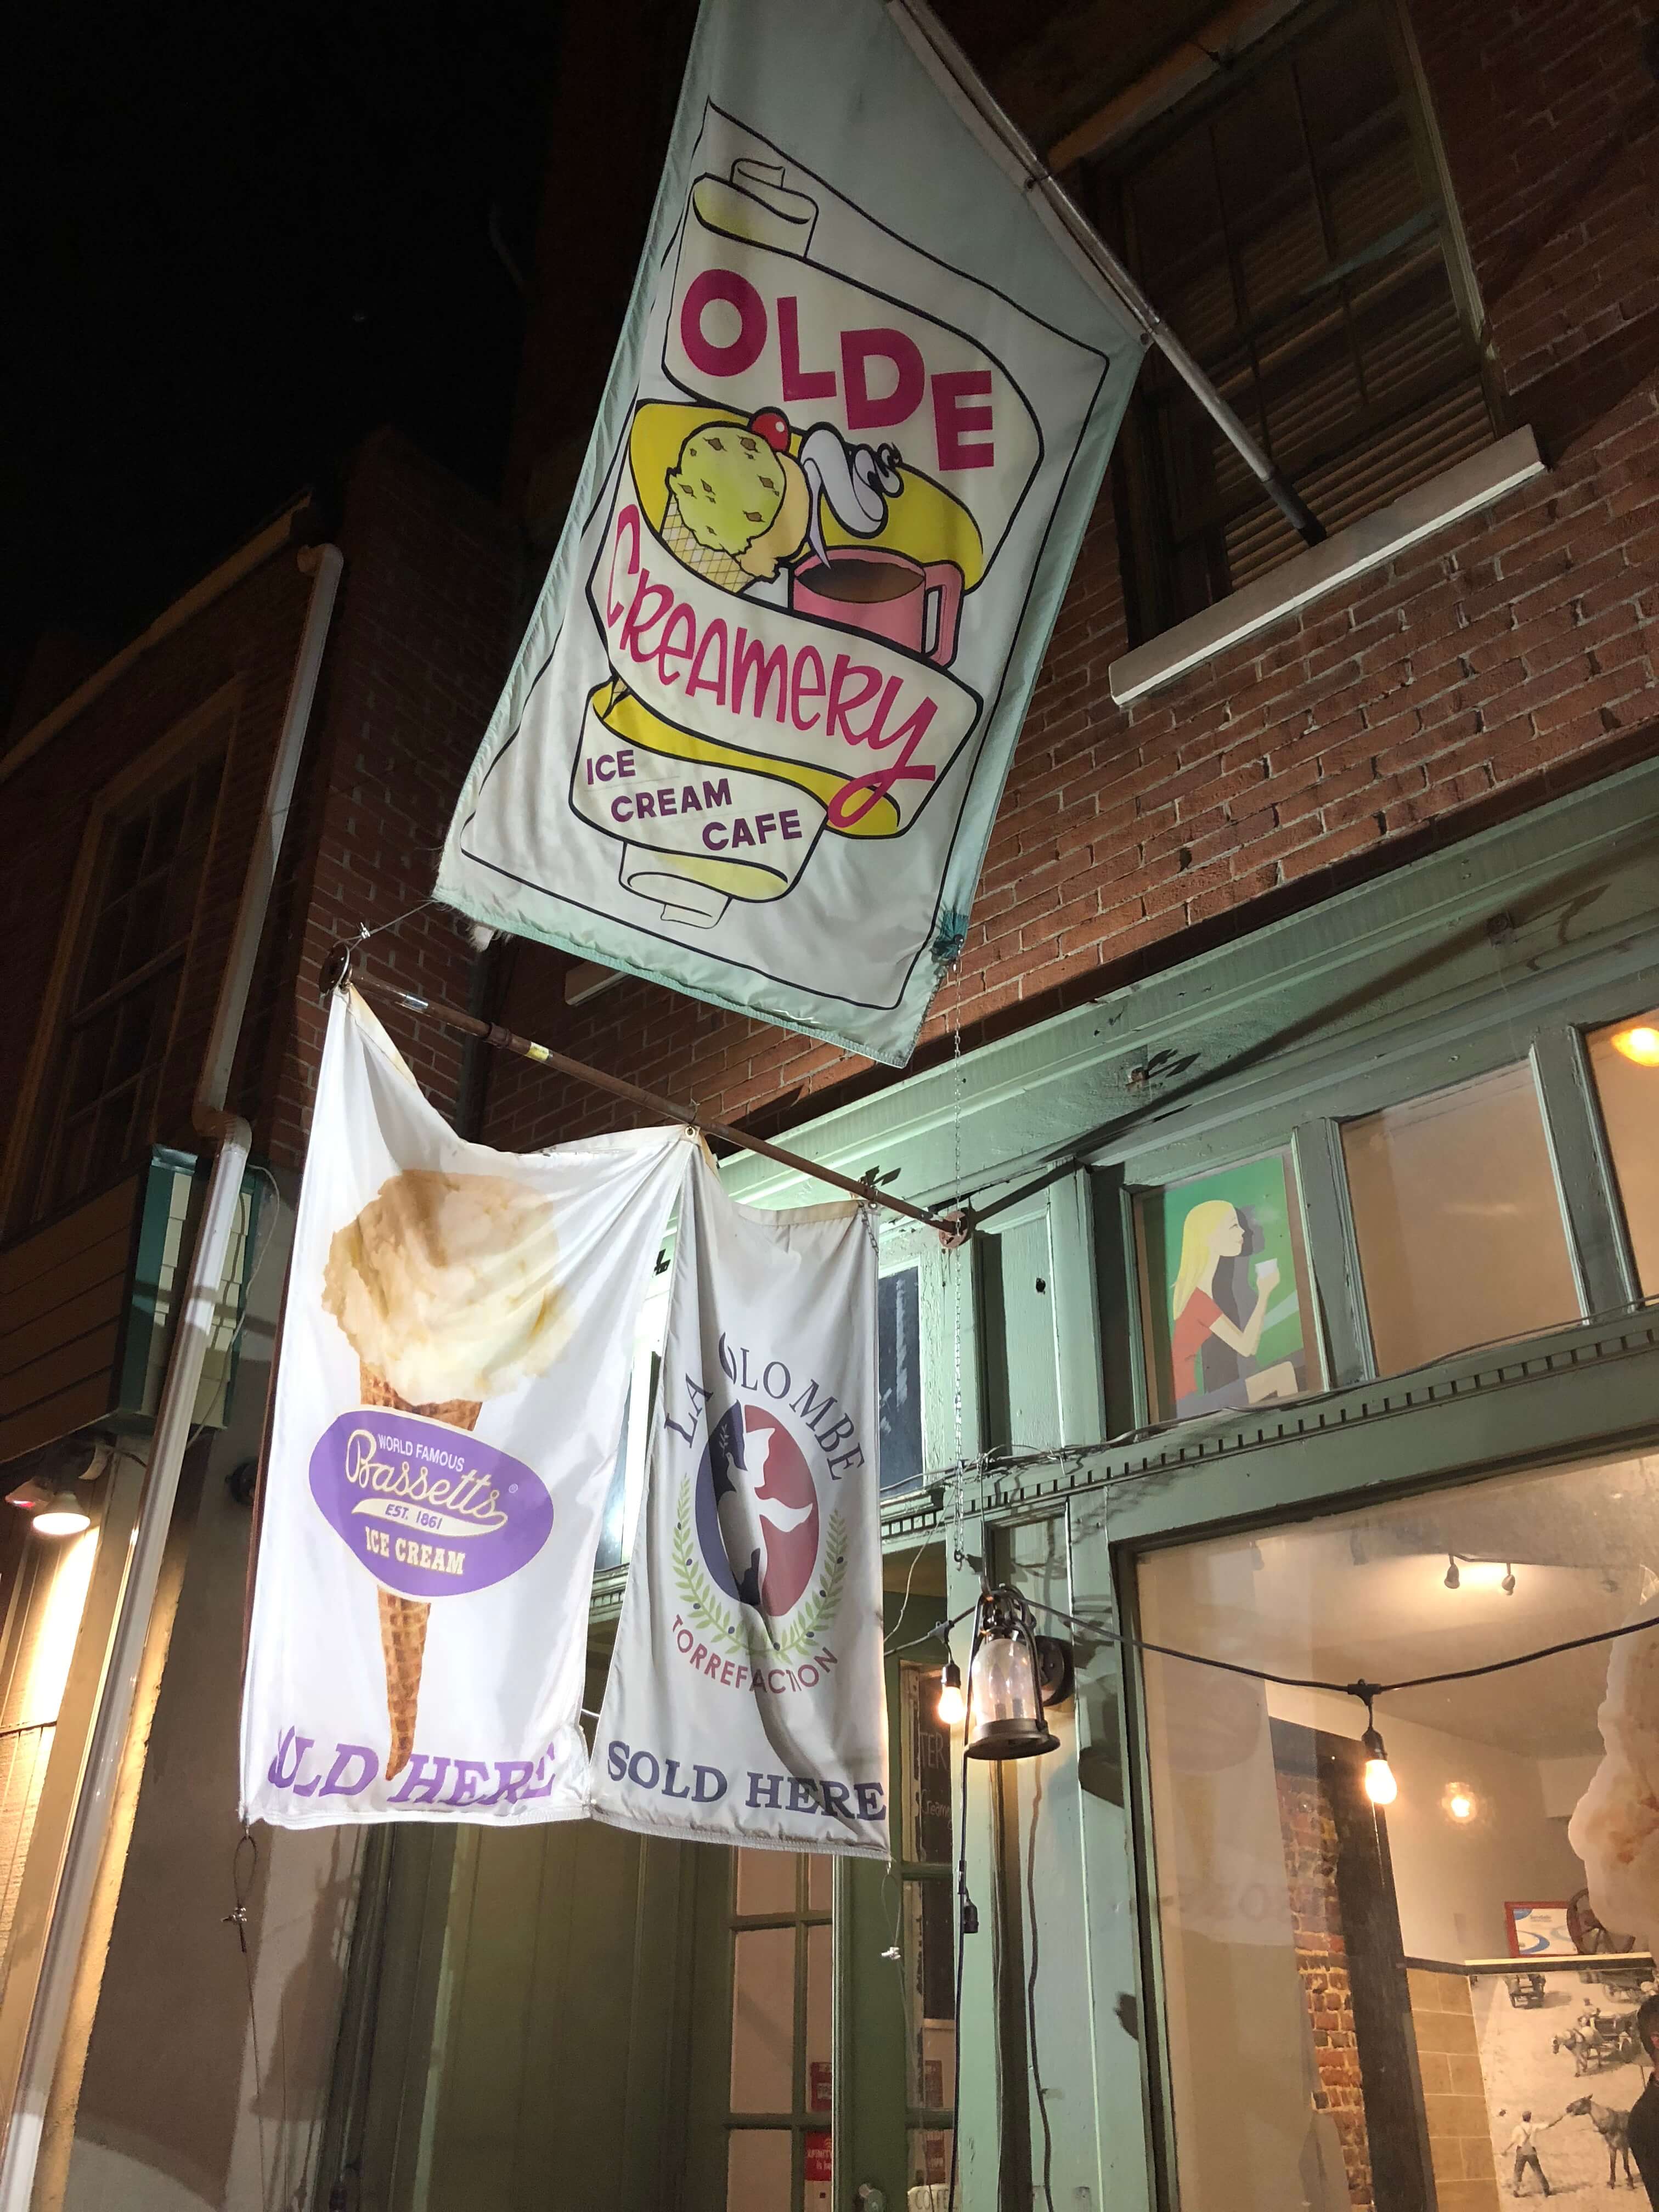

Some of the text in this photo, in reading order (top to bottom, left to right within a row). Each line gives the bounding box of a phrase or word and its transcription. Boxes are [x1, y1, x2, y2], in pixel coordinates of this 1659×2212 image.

[680, 268, 995, 471] OLDE
[586, 750, 636, 785] ICE
[611, 778, 732, 822] CREAM
[702, 809, 803, 851] CAFE
[664, 1373, 714, 1449] LA
[346, 1429, 508, 1519] Bassetts
[378, 1434, 465, 1472] WORLD FAMOUS
[385, 1503, 443, 1530] EST. 1861
[365, 1526, 466, 1575] ICE CREAM
[607, 1740, 887, 1821] SOLD HERE
